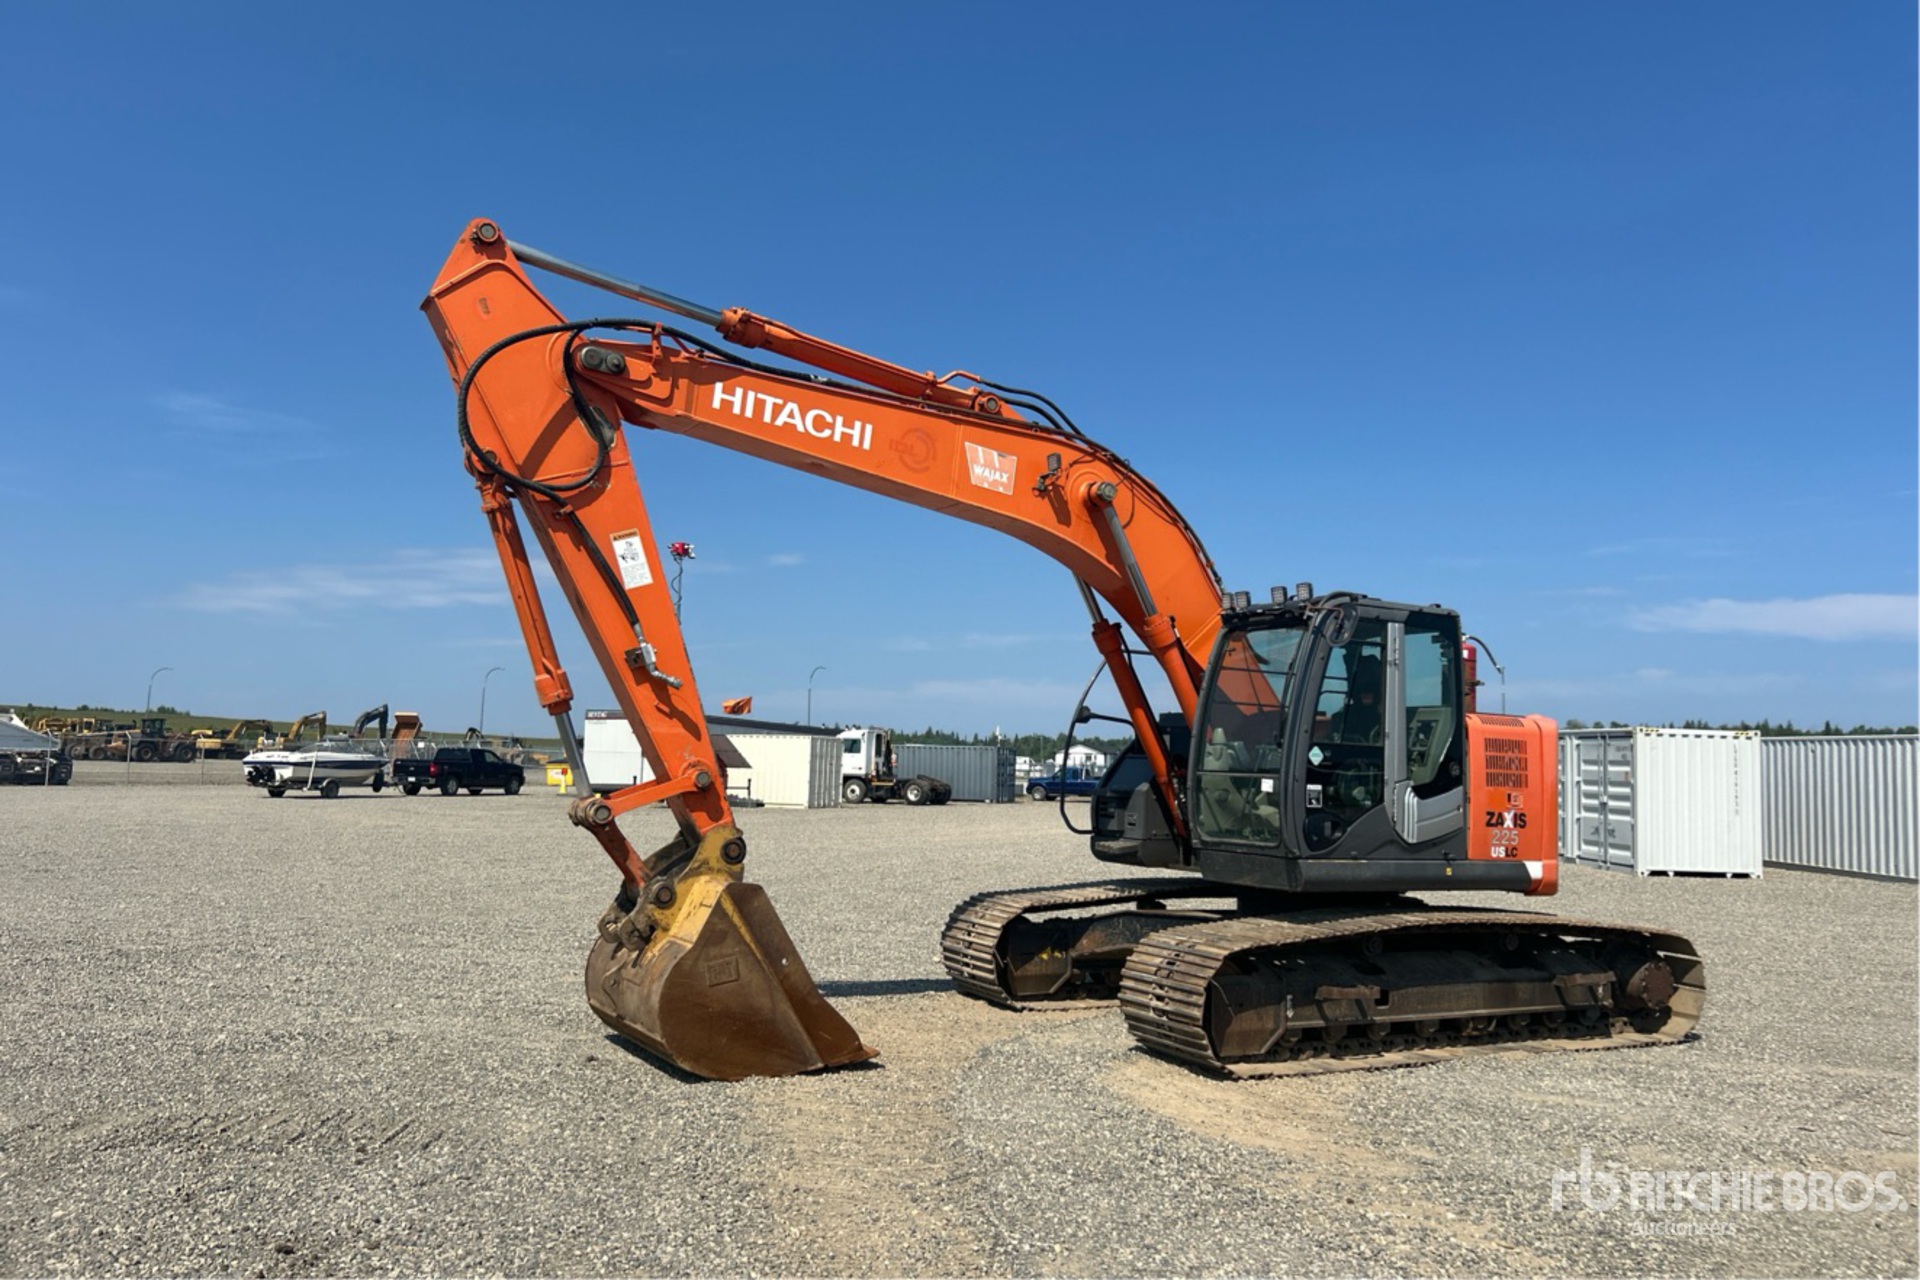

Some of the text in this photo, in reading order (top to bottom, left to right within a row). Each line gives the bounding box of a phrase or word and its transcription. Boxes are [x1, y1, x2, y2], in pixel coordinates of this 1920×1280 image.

[711, 382, 873, 450] HITACHI
[973, 464, 1008, 483] WAJAX
[1486, 809, 1527, 829] ZAXIS
[1492, 830, 1519, 845] 225
[1491, 846, 1518, 858] USLC
